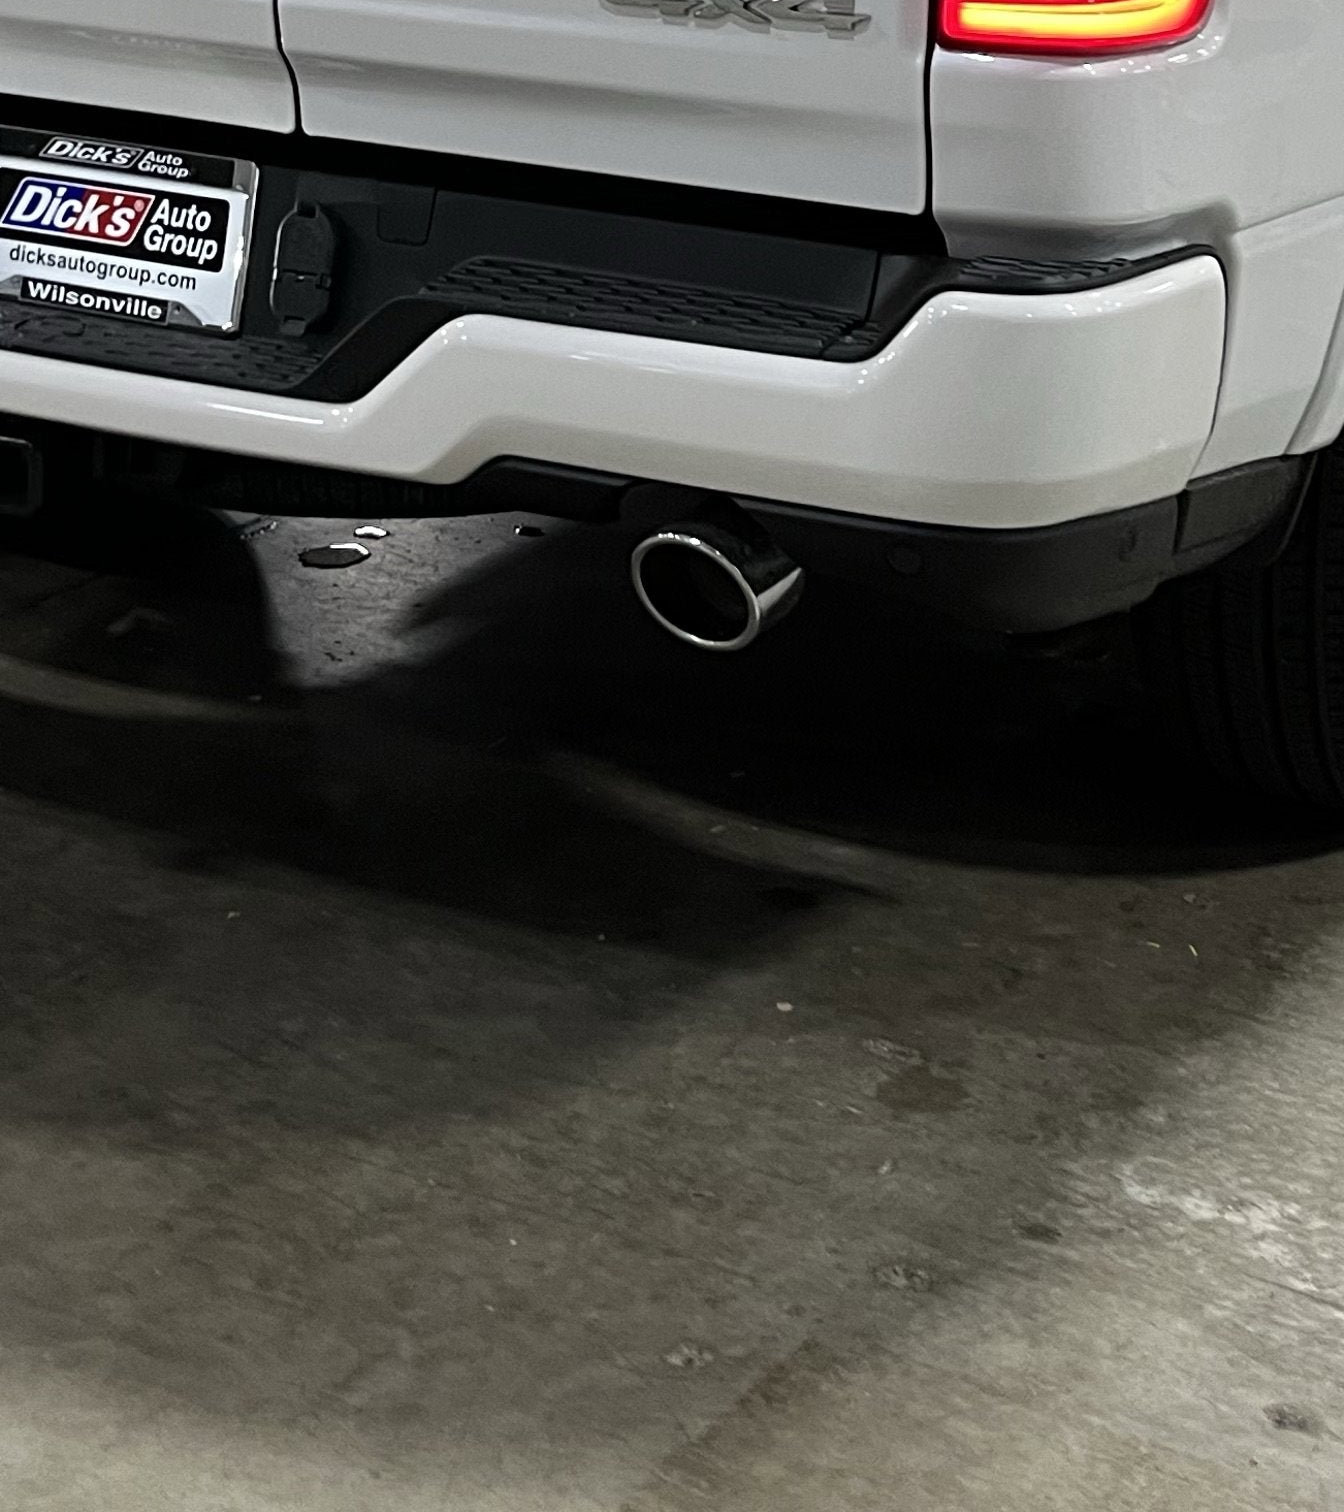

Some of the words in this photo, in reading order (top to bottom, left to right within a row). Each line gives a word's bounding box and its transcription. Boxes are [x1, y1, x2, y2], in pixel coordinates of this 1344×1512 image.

[138, 160, 189, 179] Group
[148, 150, 183, 166] Auto
[9, 184, 136, 238] Dick's
[150, 198, 212, 232] Auto
[143, 224, 219, 266] Group
[9, 244, 197, 291] dicksautogroup.com
[28, 280, 163, 320] Wilsonville
